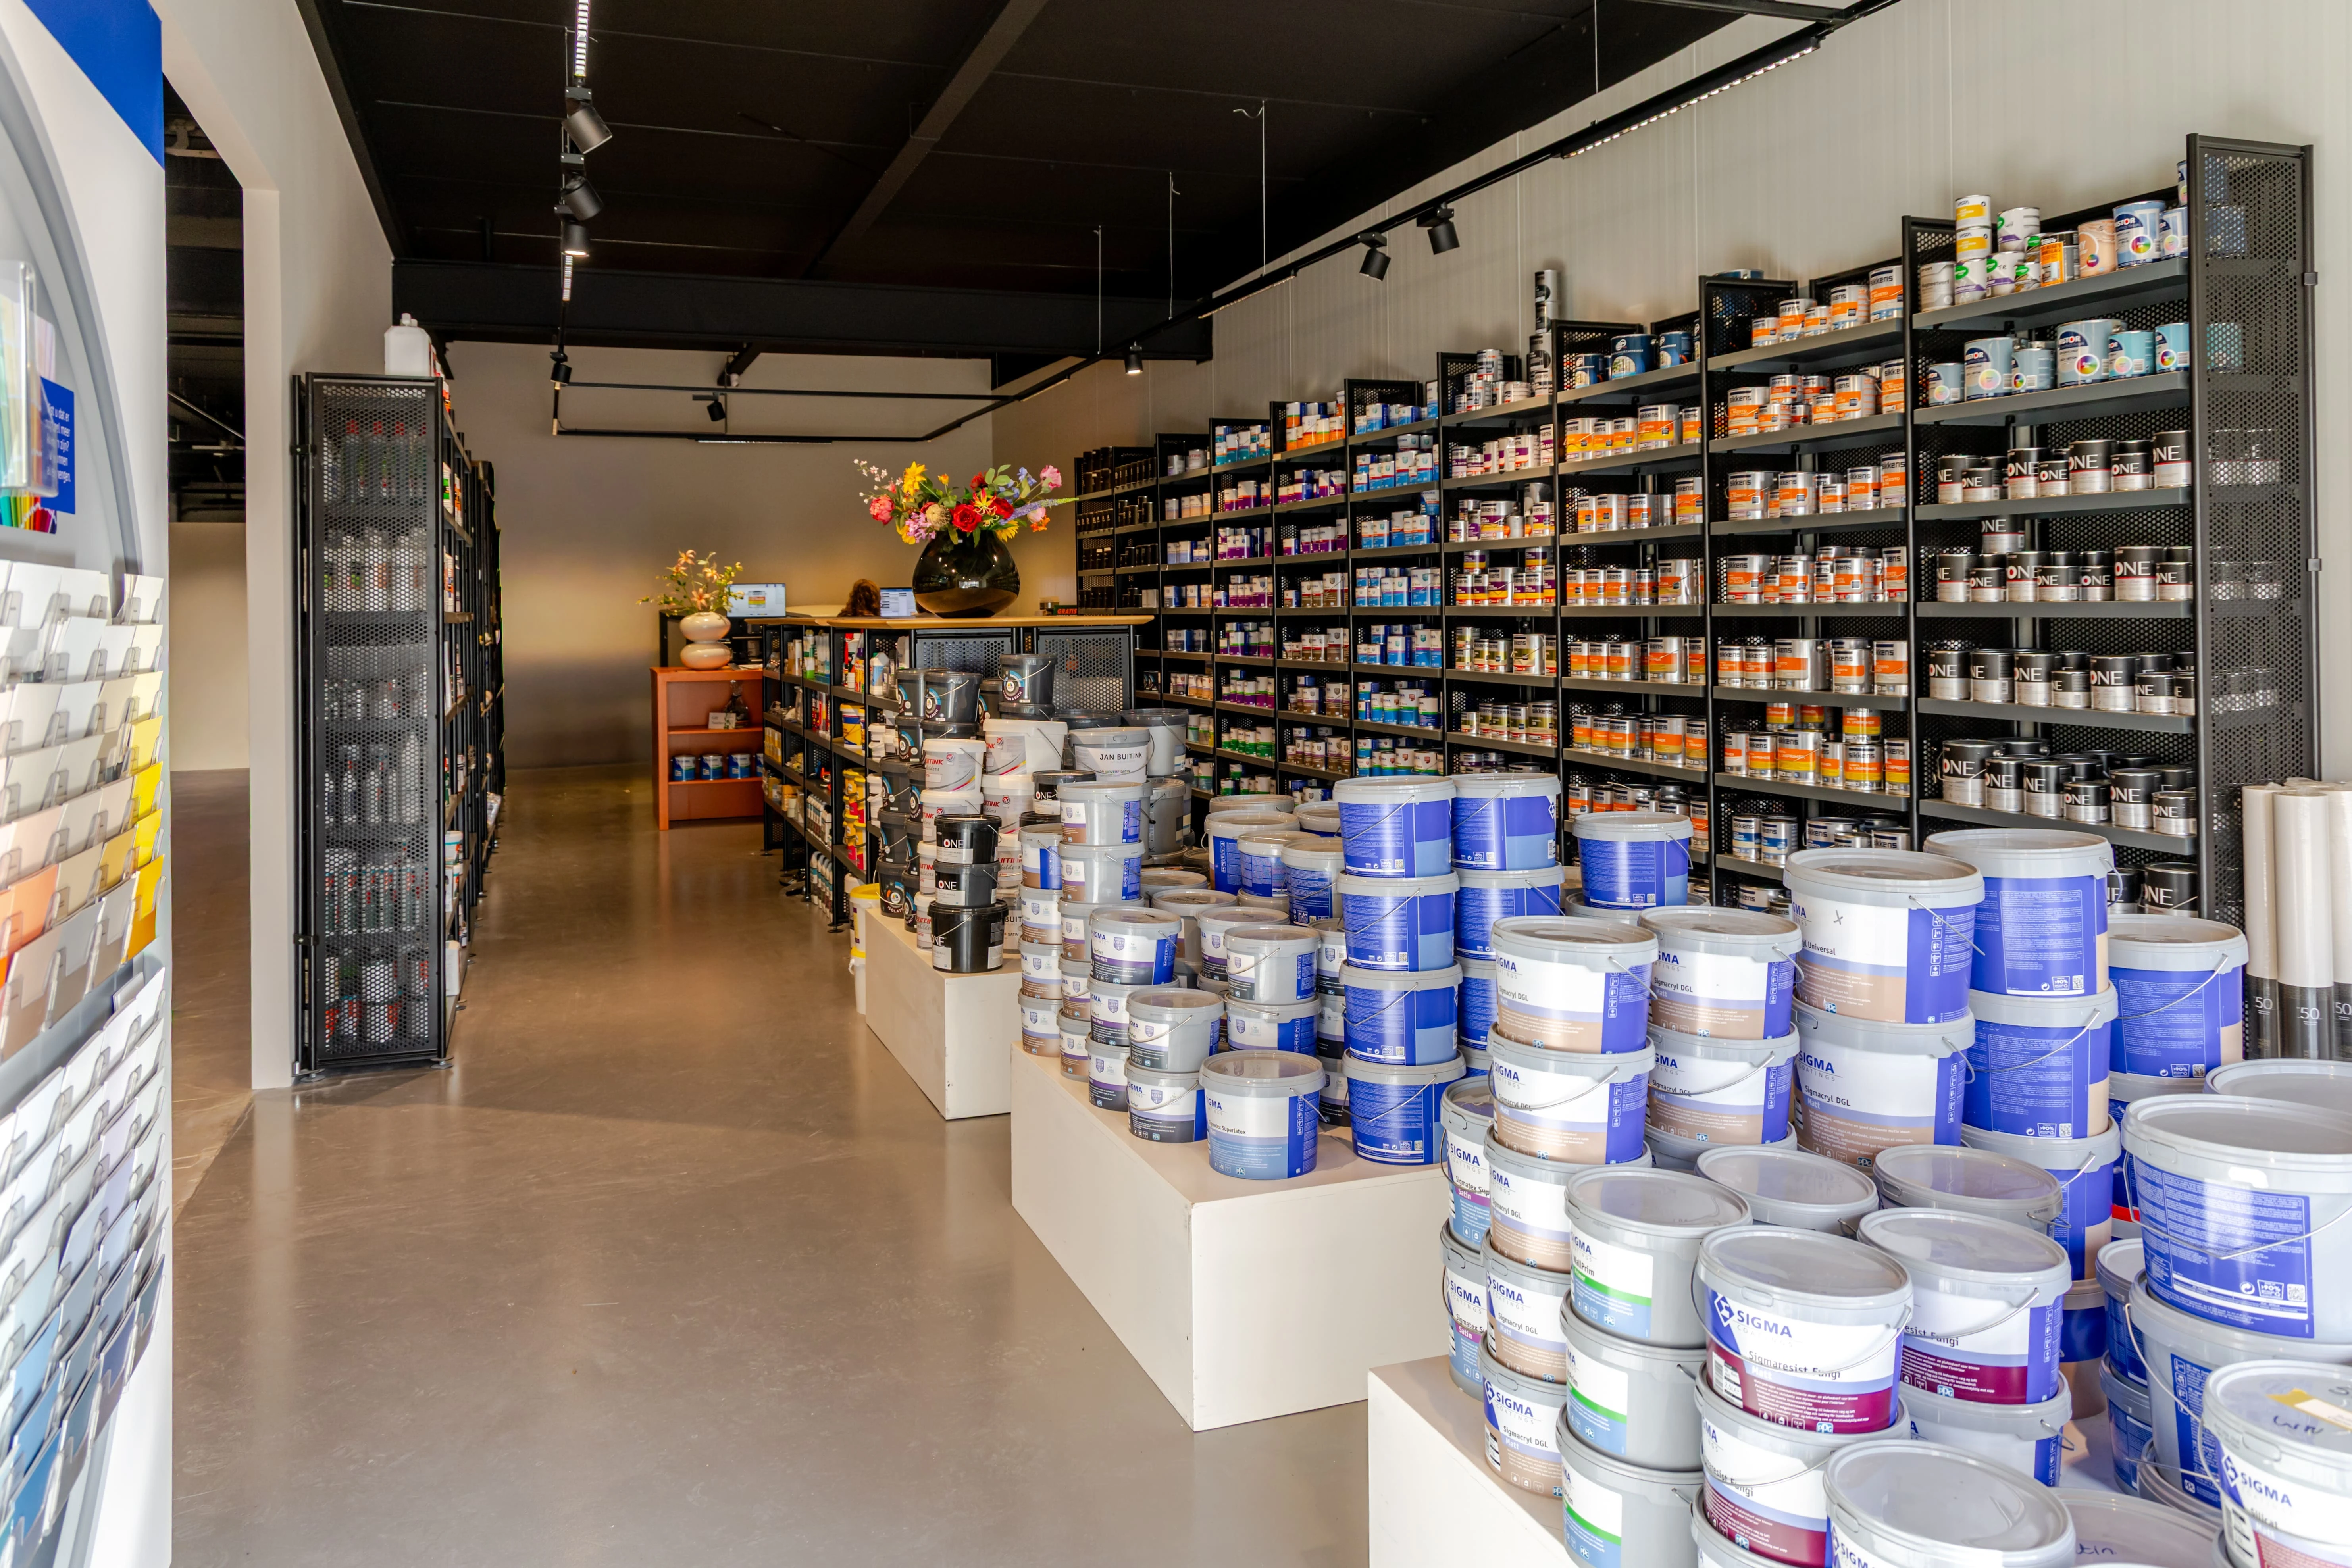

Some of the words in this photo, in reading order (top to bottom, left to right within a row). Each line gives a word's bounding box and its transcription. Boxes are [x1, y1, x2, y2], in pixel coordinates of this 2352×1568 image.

[2115, 217, 2135, 227] ISTOR
[2008, 462, 2039, 476] ONE
[2069, 454, 2099, 471] ONE
[2112, 463, 2140, 475] ONE
[2040, 469, 2067, 481] ONE
[2007, 566, 2042, 579] ONE
[2115, 561, 2150, 576] ONE
[1970, 577, 1992, 587] ONE
[2082, 575, 2111, 586] ONE
[1929, 664, 1957, 677] ONE
[2091, 671, 2123, 685] ONE
[1943, 758, 1975, 775] ONE
[1036, 791, 1052, 800] ONE
[2065, 793, 2091, 805] ONE
[2153, 804, 2179, 818] ONE
[943, 839, 964, 848] ONE
[938, 880, 957, 890] ONE
[1092, 930, 1106, 941] SIGMA
[1808, 941, 1835, 955] Universal
[1496, 955, 1517, 972] SIGMA
[1654, 977, 1678, 990] Sigmacryl
[1499, 985, 1516, 999] Sigmacryl
[1656, 988, 1667, 997] Matt
[2255, 997, 2273, 1010] 50
[2335, 1002, 2352, 1015] 50
[2300, 1007, 2320, 1020] 50
[1655, 1053, 1678, 1068] GMA
[1799, 1050, 1834, 1074] SIGMA
[1495, 1062, 1519, 1081] SIGMA
[1799, 1063, 1835, 1081] COATINGS
[1128, 1081, 1143, 1093] SIGMA
[1654, 1091, 1666, 1100] Matt
[1805, 1085, 1834, 1102] Sigmacryl
[1836, 1097, 1851, 1106] DGL
[1807, 1098, 1821, 1109] Matt
[1222, 1125, 1246, 1134] Superlatex
[1450, 1143, 1480, 1166] SIGMA
[1451, 1155, 1481, 1174] COATINGS
[1857, 1157, 1872, 1167] PPG
[1456, 1176, 1477, 1190] Sigmatex
[1490, 1165, 1510, 1188] SIGMA
[1458, 1188, 1471, 1200] Satin
[1511, 1210, 1521, 1219] DGL
[1571, 1232, 1592, 1255] SIGMA
[1573, 1256, 1594, 1276] WallPrim
[1450, 1280, 1482, 1307] SIGMA
[1493, 1279, 1524, 1304] SIGMA
[1450, 1291, 1482, 1314] COATINGS
[1493, 1291, 1524, 1311] COATINGS
[1456, 1314, 1478, 1331] Sigmatex
[1498, 1312, 1523, 1330] Sigmacryl
[1526, 1326, 1538, 1335] DGL
[1737, 1310, 1792, 1339] SIGMA
[1459, 1326, 1472, 1339] Satin
[1500, 1324, 1512, 1336] Matt
[1748, 1351, 1808, 1374] Sigmaresist
[1751, 1365, 1772, 1380] Matt
[1496, 1392, 1534, 1418] SIGMA
[1496, 1403, 1534, 1424] COATINGS
[1503, 1426, 1532, 1444] Sigmacryl
[1535, 1439, 1548, 1448] DGL
[1505, 1438, 1519, 1450] Matt
[2241, 1472, 2292, 1507] SIGMA
